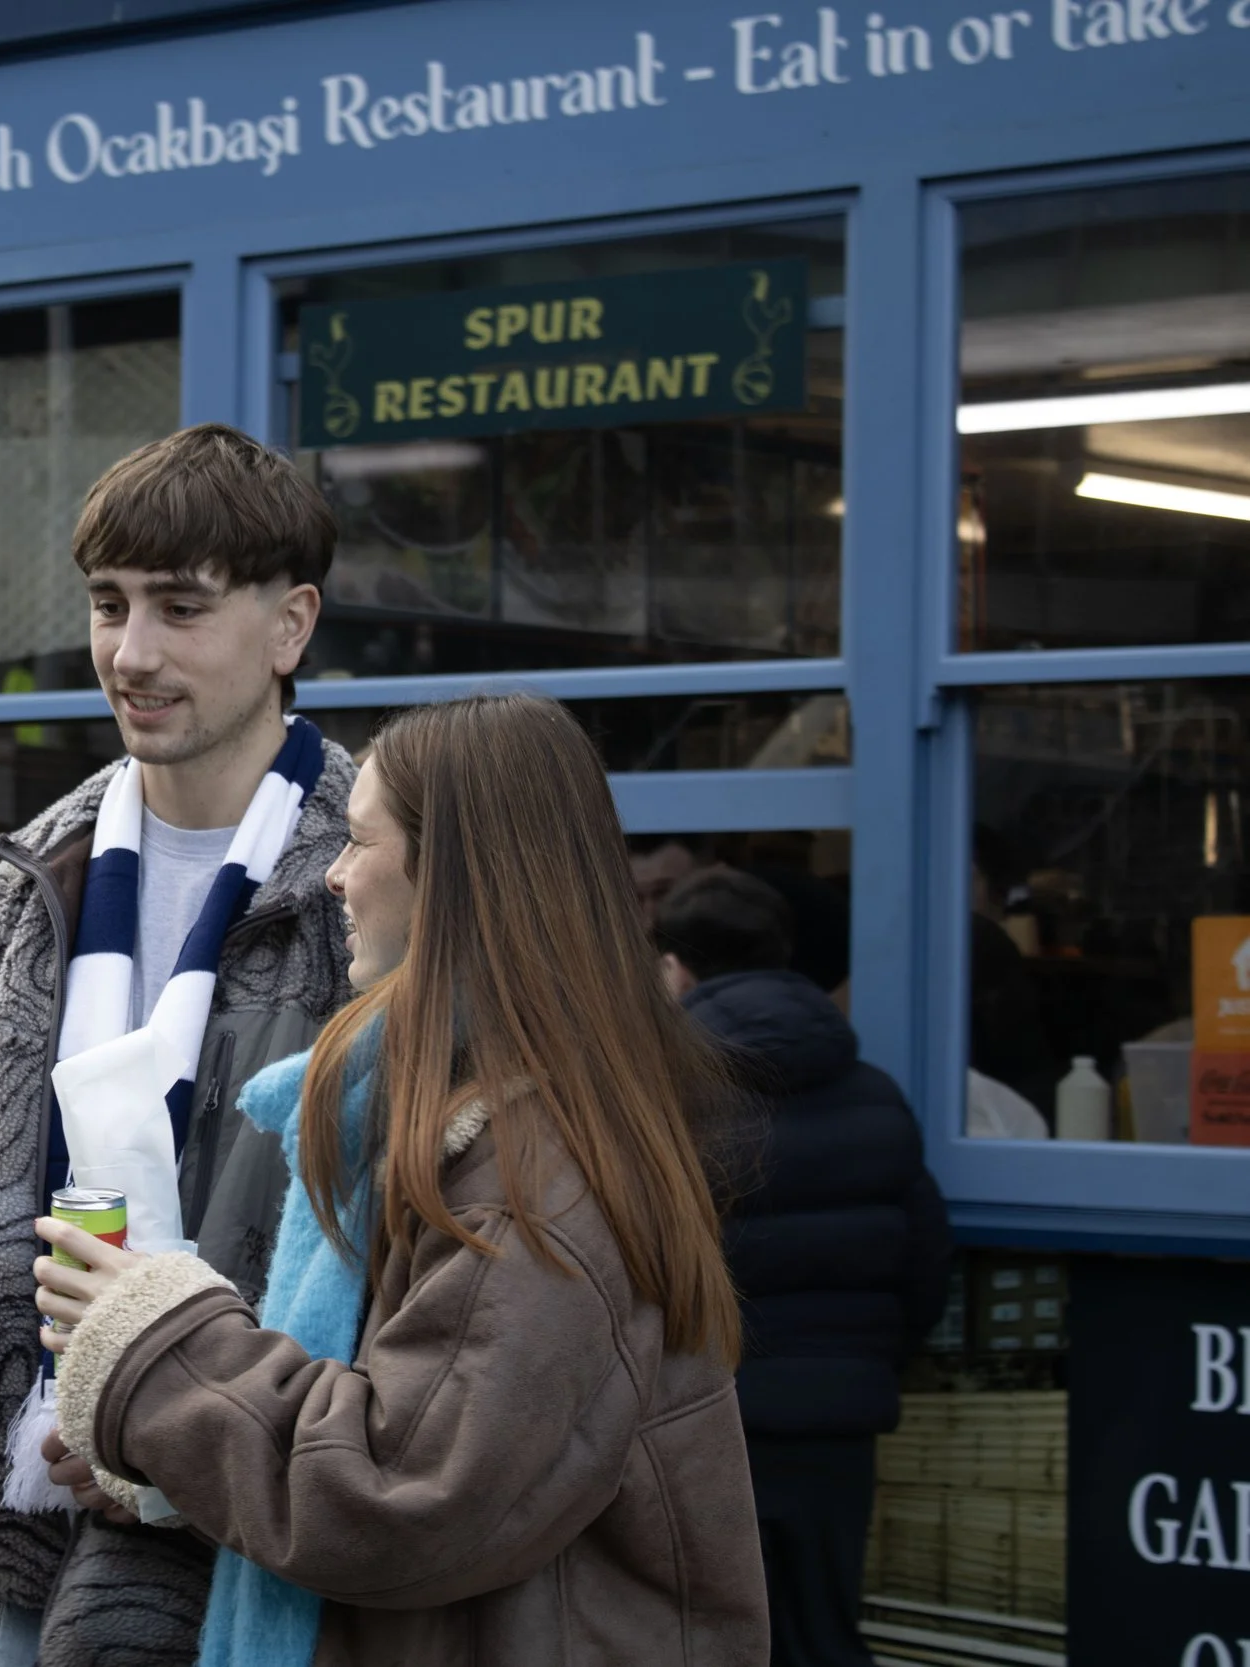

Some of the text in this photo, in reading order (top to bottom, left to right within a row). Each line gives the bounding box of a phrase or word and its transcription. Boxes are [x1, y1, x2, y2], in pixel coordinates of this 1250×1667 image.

[320, 31, 668, 149] Restaurant
[730, 6, 851, 95] Eat
[863, 13, 933, 78] in
[947, 9, 1033, 65] or
[463, 296, 604, 350] SPUR
[372, 352, 720, 423] RESTAURANT
